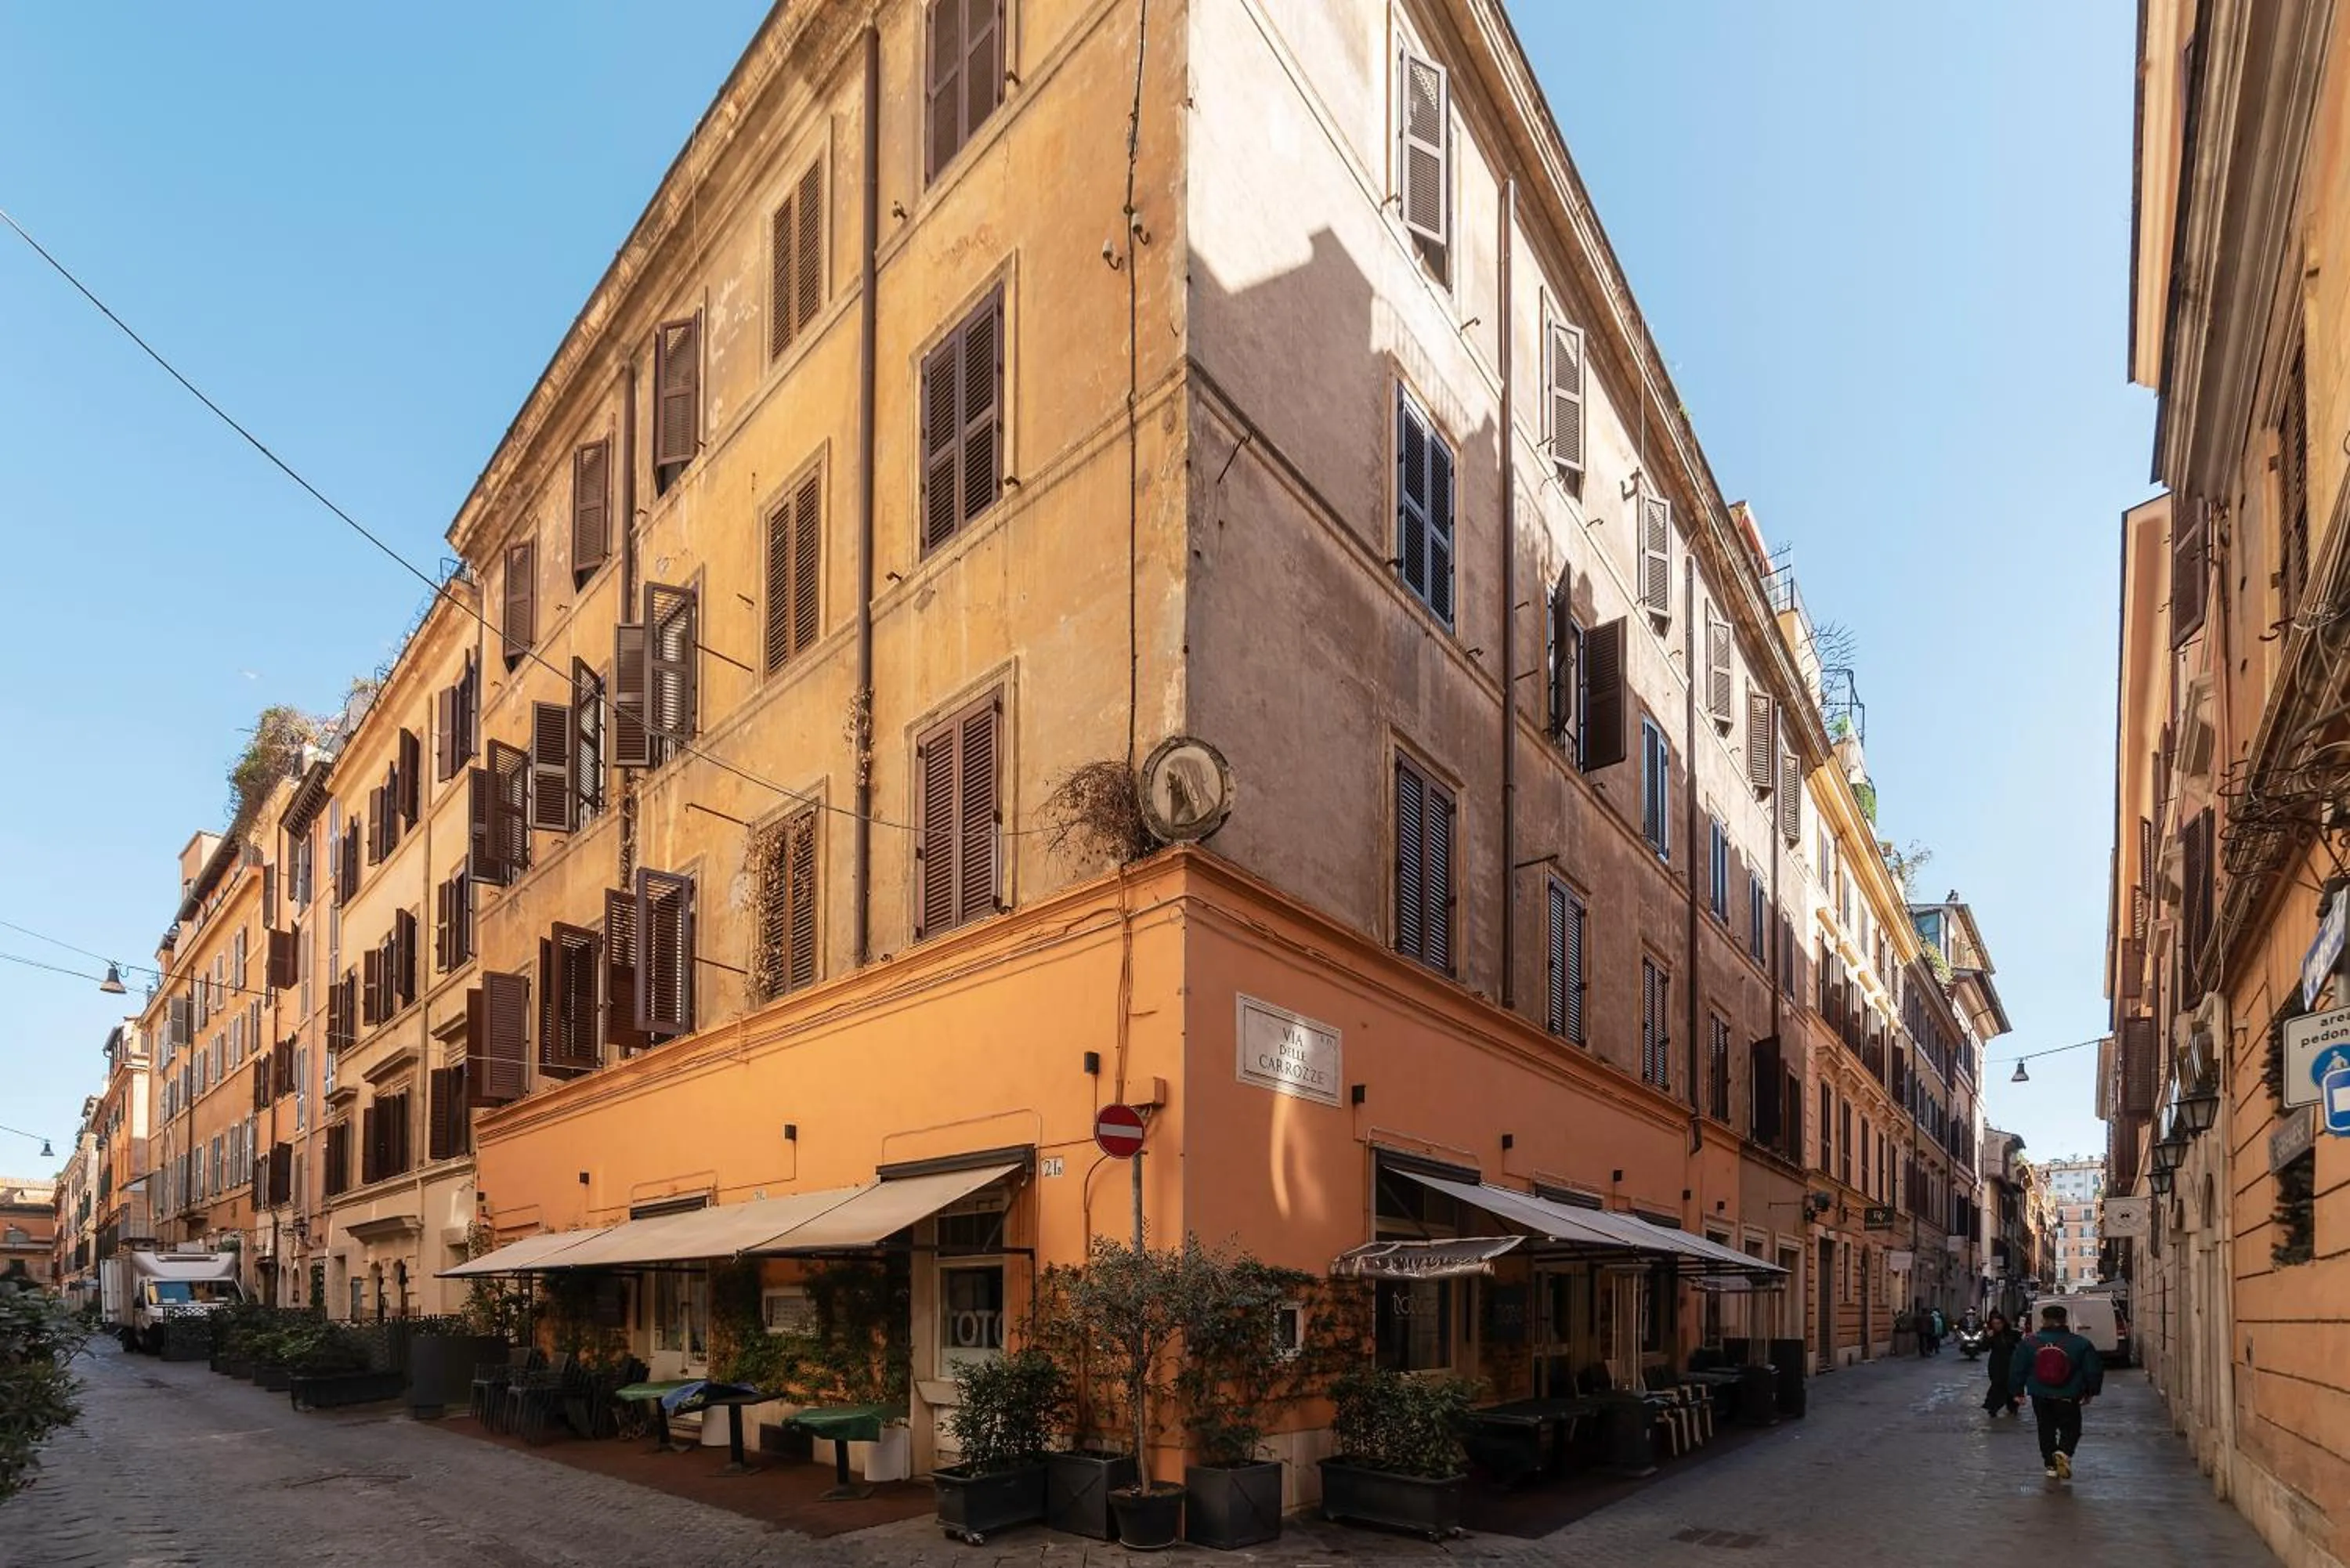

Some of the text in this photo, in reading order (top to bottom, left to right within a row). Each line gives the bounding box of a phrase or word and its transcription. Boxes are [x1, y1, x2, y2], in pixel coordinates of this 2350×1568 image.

[1282, 1027, 1303, 1046] VIA
[1279, 1043, 1306, 1063] DELLE
[1259, 1053, 1327, 1086] CARROZZE
